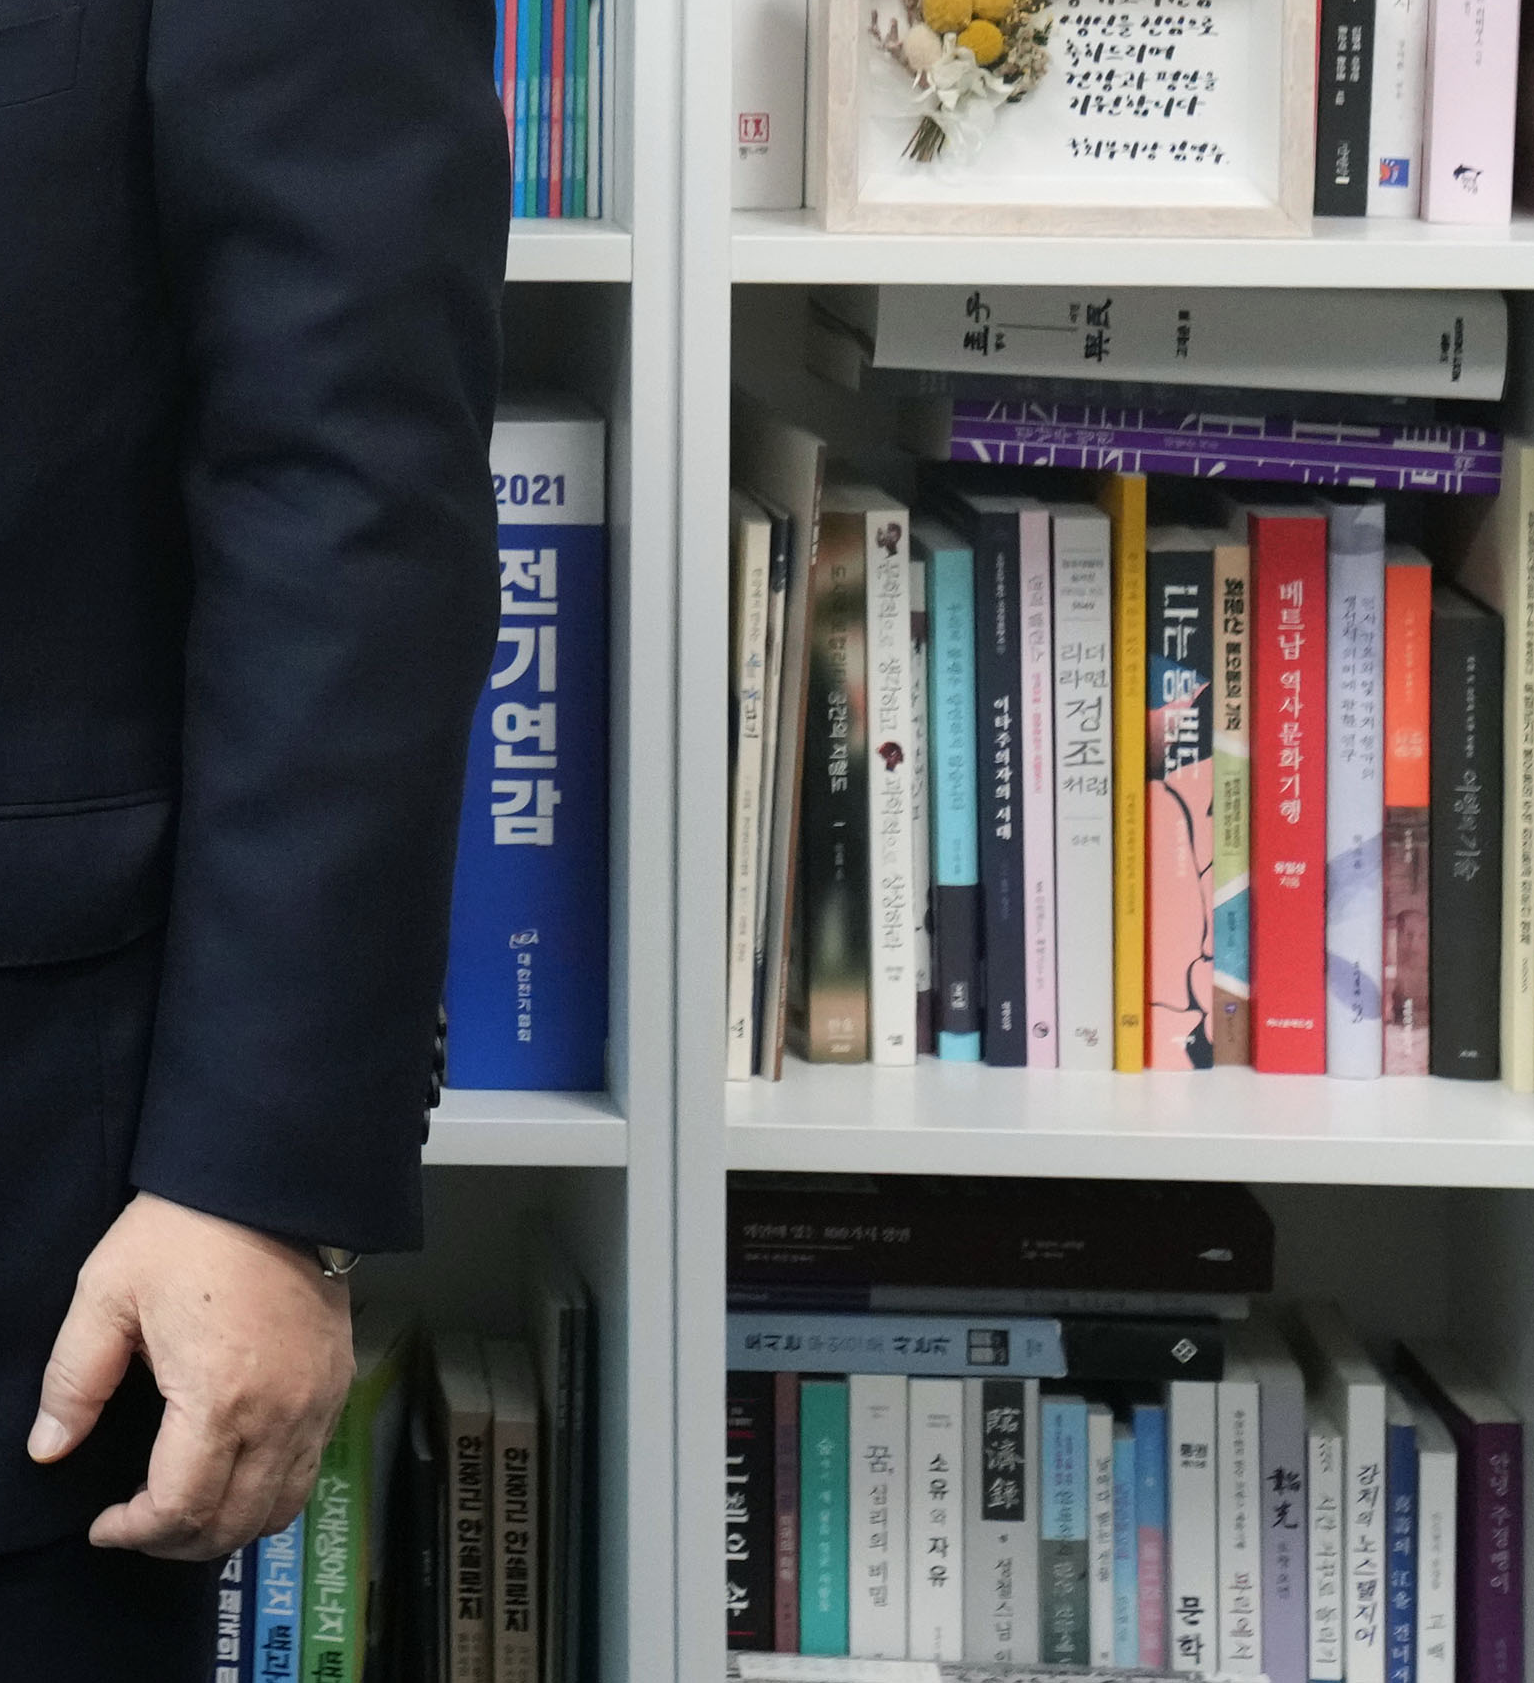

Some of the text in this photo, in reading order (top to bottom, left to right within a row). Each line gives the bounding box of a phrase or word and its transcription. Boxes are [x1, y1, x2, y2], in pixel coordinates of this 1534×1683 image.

[1066, 38, 1176, 67] 축하드리며
[1066, 68, 1219, 92] 건강과 평안을
[1069, 93, 1207, 118] 기원합니다
[1066, 137, 1163, 161] 국회부의장
[490, 473, 566, 507] 2021
[490, 546, 561, 847] 전기연감
[877, 657, 903, 731] 생각하고
[1161, 583, 1201, 780] 나는 홍범도
[1276, 580, 1305, 825] 베트남 역사문화기행
[1063, 695, 1107, 769] 정조
[1063, 773, 1109, 798] 처럼
[995, 804, 1013, 841] 시대
[261, 1523, 296, 1615] 에너지
[311, 1475, 351, 1643] 신재생에너지
[1175, 1595, 1205, 1665] 문학
